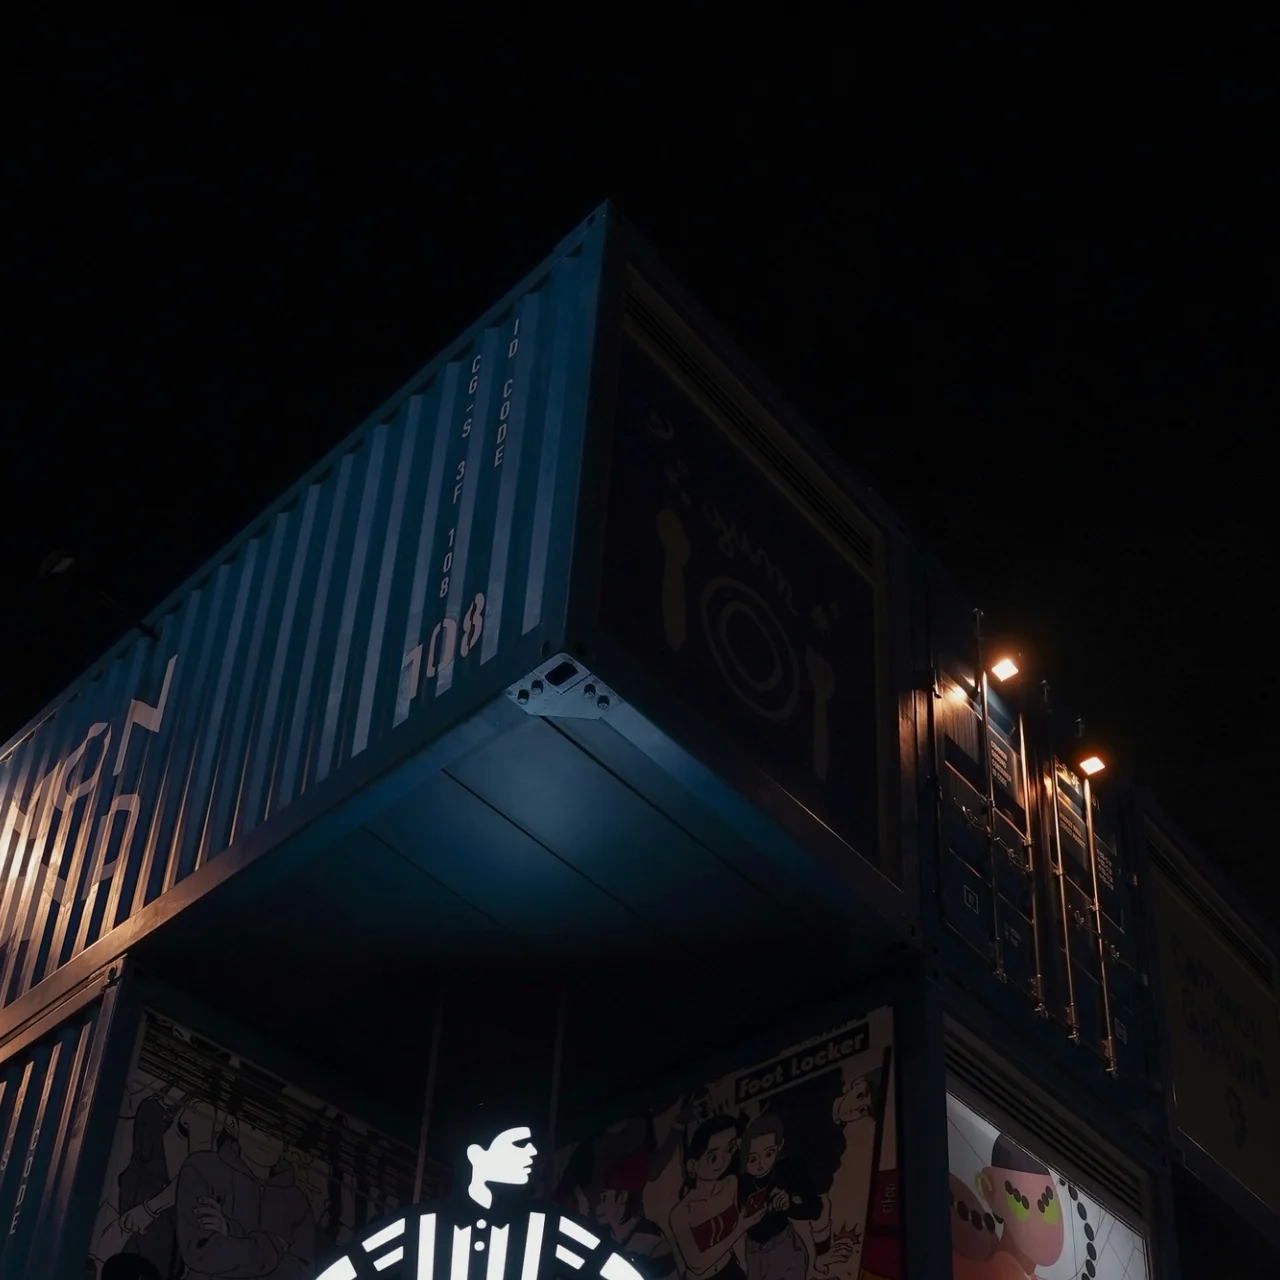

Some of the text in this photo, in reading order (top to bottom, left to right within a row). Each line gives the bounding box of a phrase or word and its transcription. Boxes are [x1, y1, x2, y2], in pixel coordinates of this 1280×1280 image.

[492, 379, 515, 469] CODE
[438, 529, 455, 600] 108
[738, 1030, 867, 1100] Foot Locker
